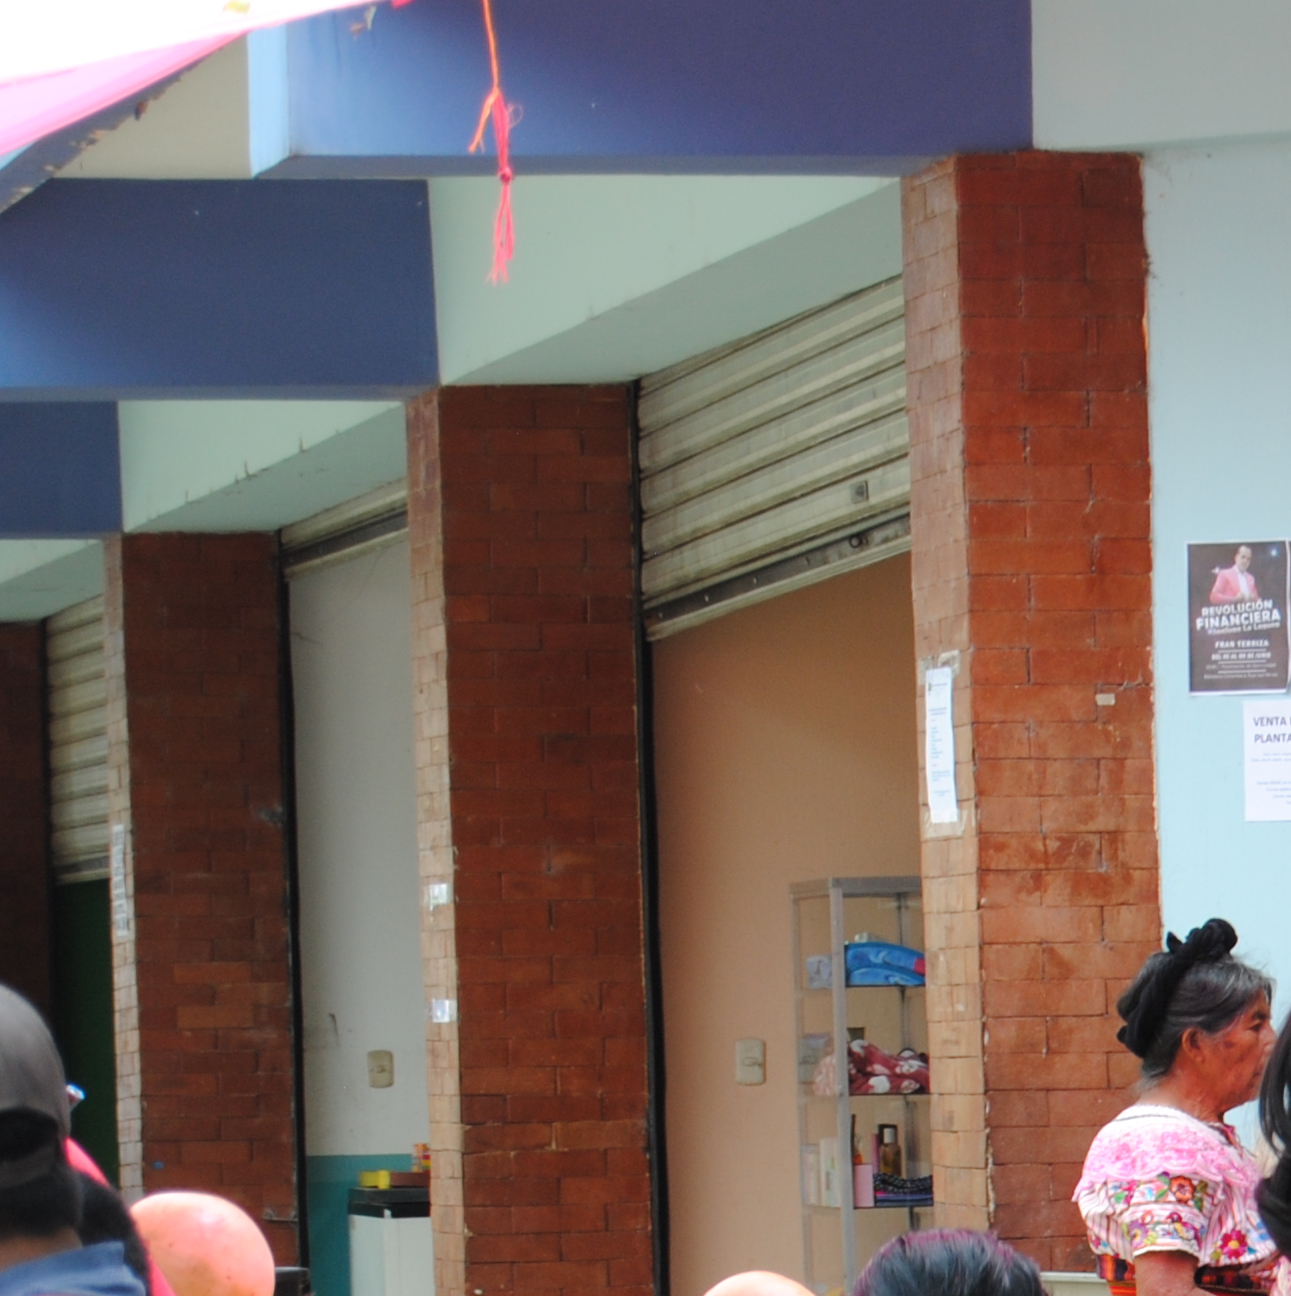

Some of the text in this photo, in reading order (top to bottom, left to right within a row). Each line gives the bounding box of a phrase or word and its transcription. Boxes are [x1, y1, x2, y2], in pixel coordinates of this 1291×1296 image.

[1201, 599, 1272, 617] REVOLUCIÓN
[1196, 607, 1281, 630] FINANCIERA
[1253, 716, 1287, 727] VENTA
